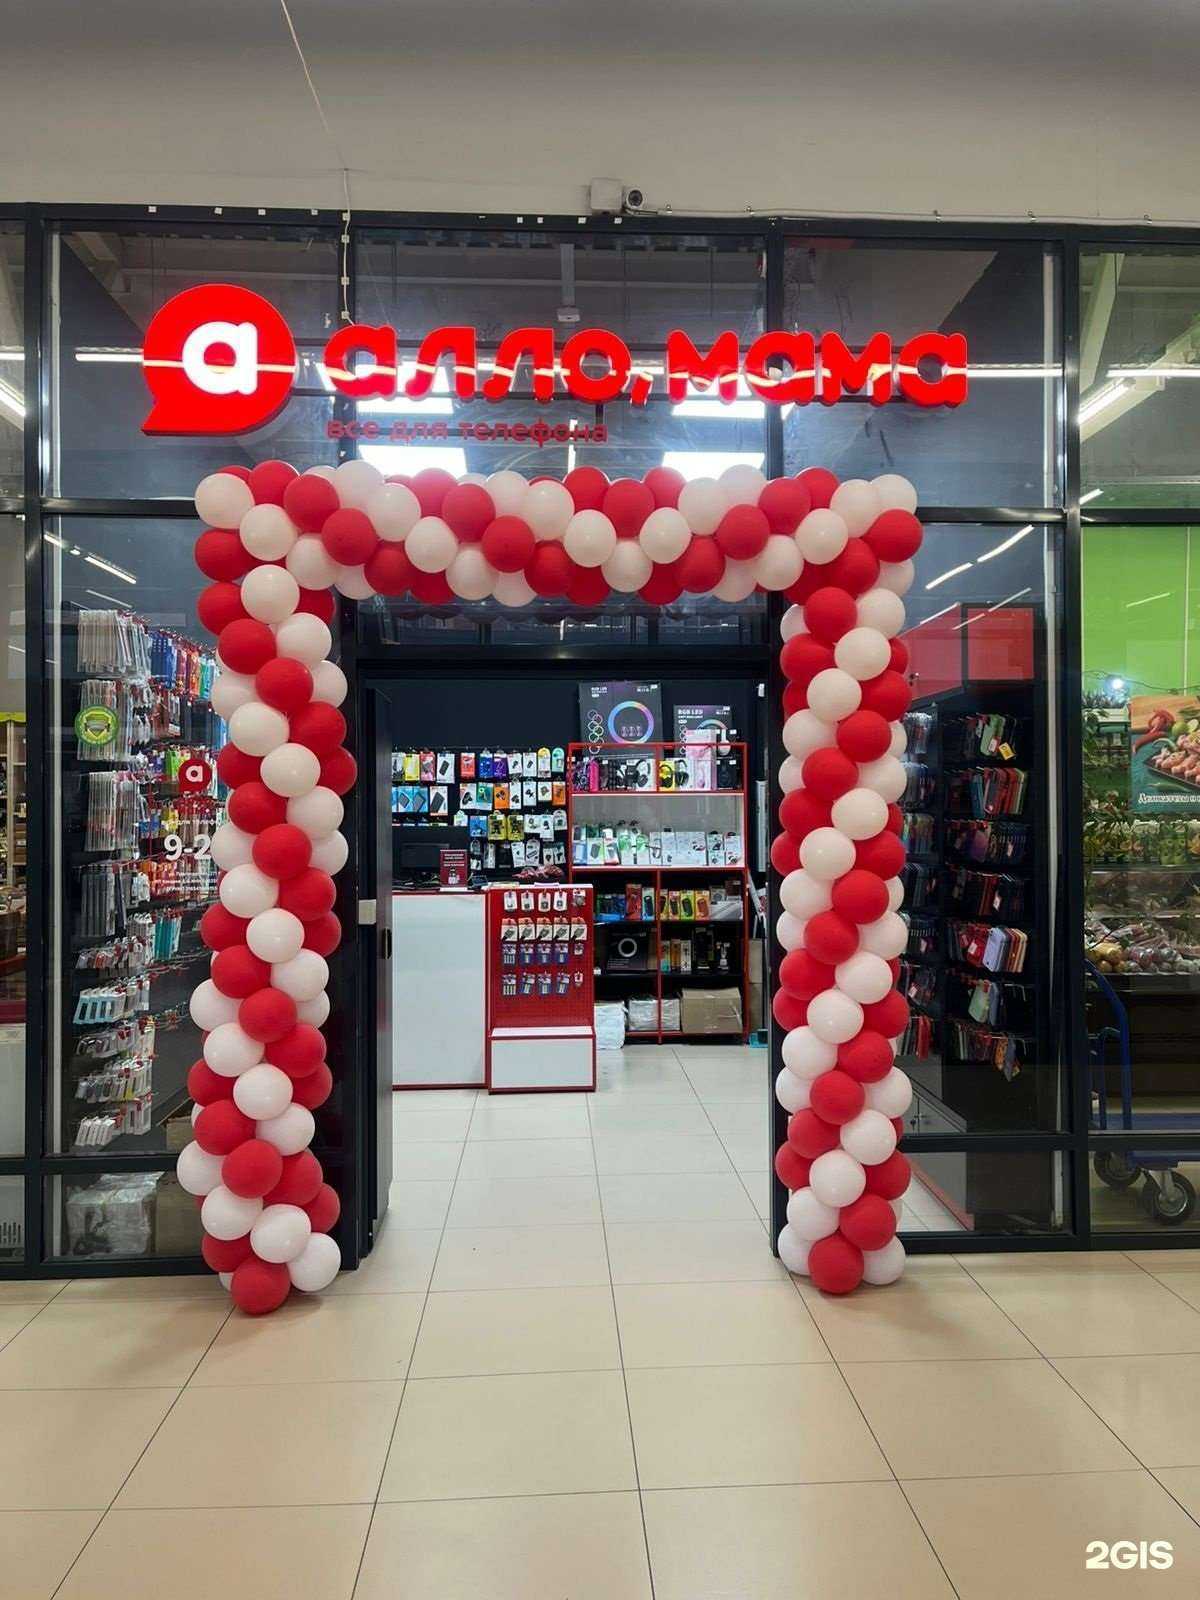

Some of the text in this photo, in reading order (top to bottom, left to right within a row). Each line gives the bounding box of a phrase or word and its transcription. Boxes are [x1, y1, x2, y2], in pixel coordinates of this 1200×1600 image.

[666, 330, 969, 408] мама
[327, 417, 609, 448] все для телефона
